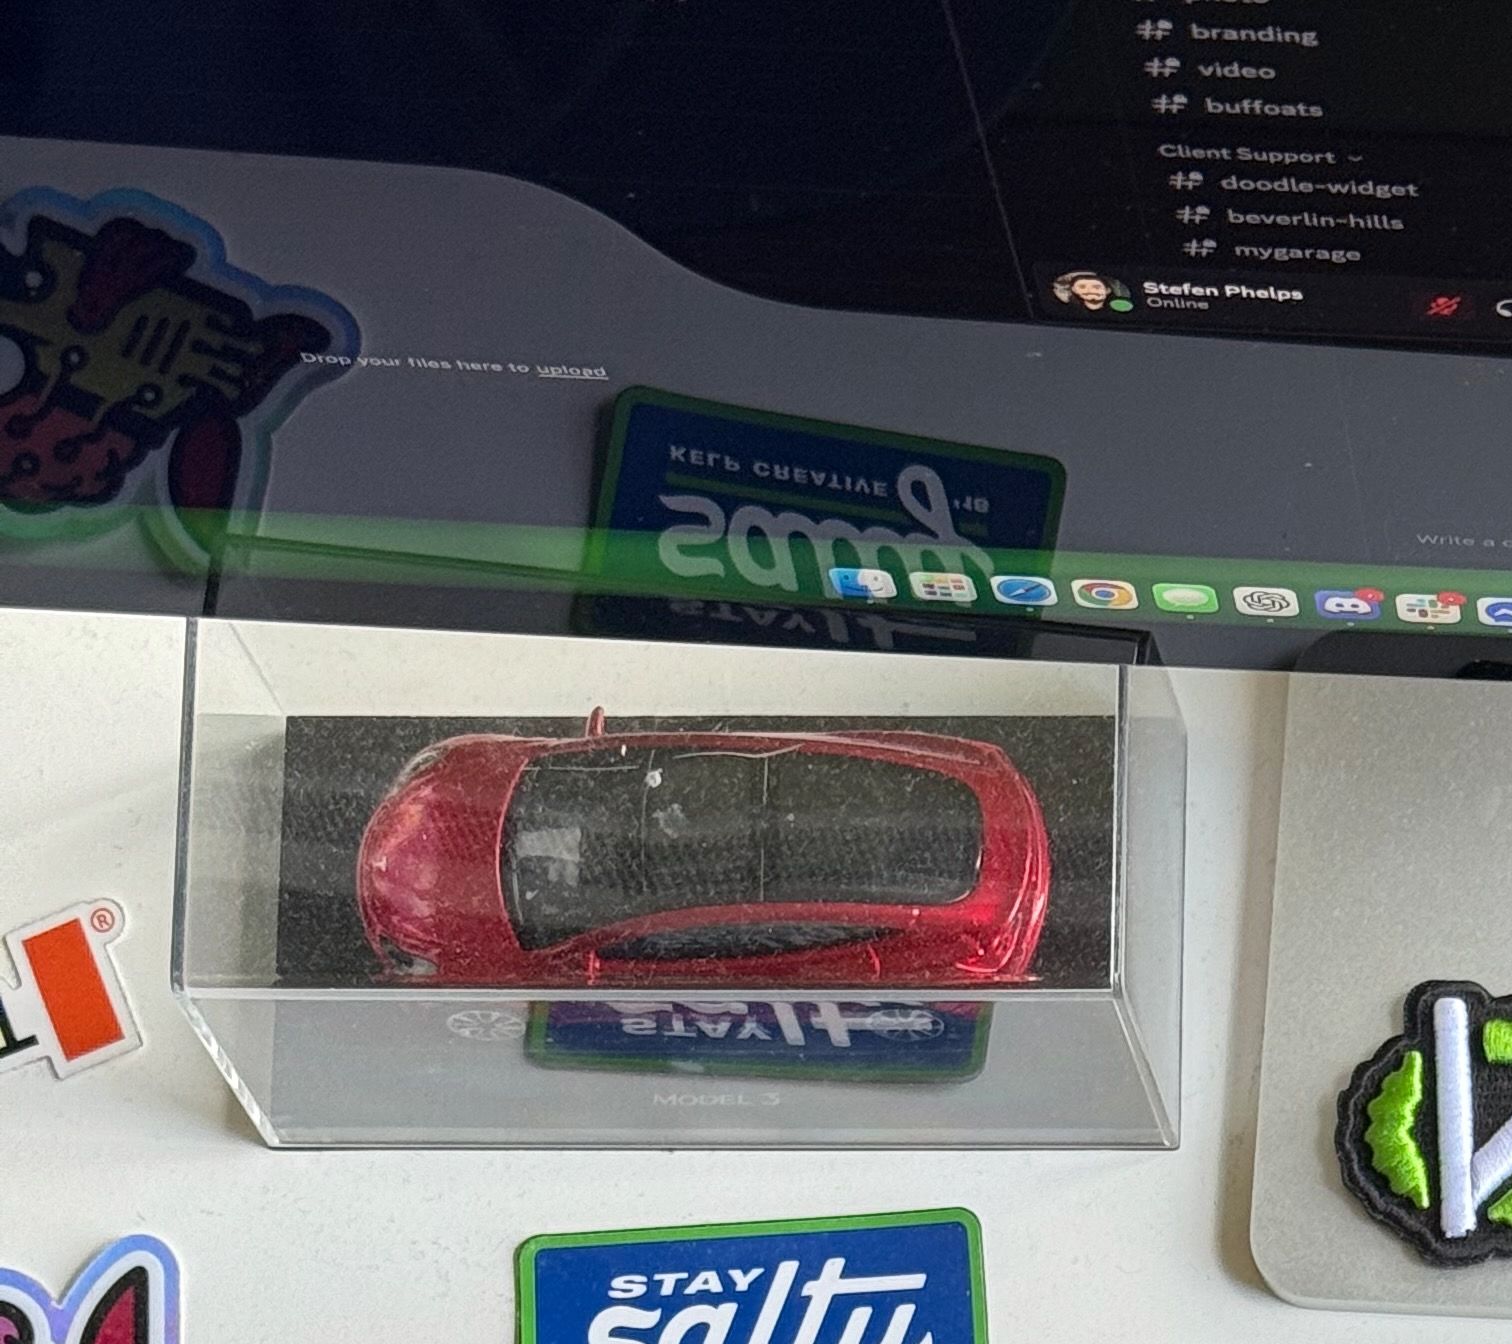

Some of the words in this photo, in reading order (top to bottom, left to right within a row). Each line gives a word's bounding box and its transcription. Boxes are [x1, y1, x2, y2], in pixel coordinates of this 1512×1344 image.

[1191, 23, 1319, 47] branding
[1199, 61, 1276, 81] video
[1205, 97, 1323, 118] buffoats
[1159, 143, 1230, 161] Client
[1236, 147, 1335, 167] Support
[1220, 174, 1419, 199] doodle-widget
[1227, 208, 1404, 231] beverlin-hills
[1235, 243, 1361, 263] mygarage
[1143, 281, 1220, 298] Stefen
[1225, 284, 1303, 302] Phelps
[1146, 297, 1209, 310] Online
[301, 351, 351, 369] Drop
[357, 356, 400, 370] your
[408, 357, 452, 370] files
[456, 359, 502, 373] here
[508, 362, 530, 373] to
[537, 362, 608, 379] upload
[1416, 534, 1476, 547] Write
[1482, 539, 1496, 548] a
[653, 1092, 748, 1107] MODEL
[761, 1092, 780, 1107] 3
[607, 1267, 765, 1299] STAY
